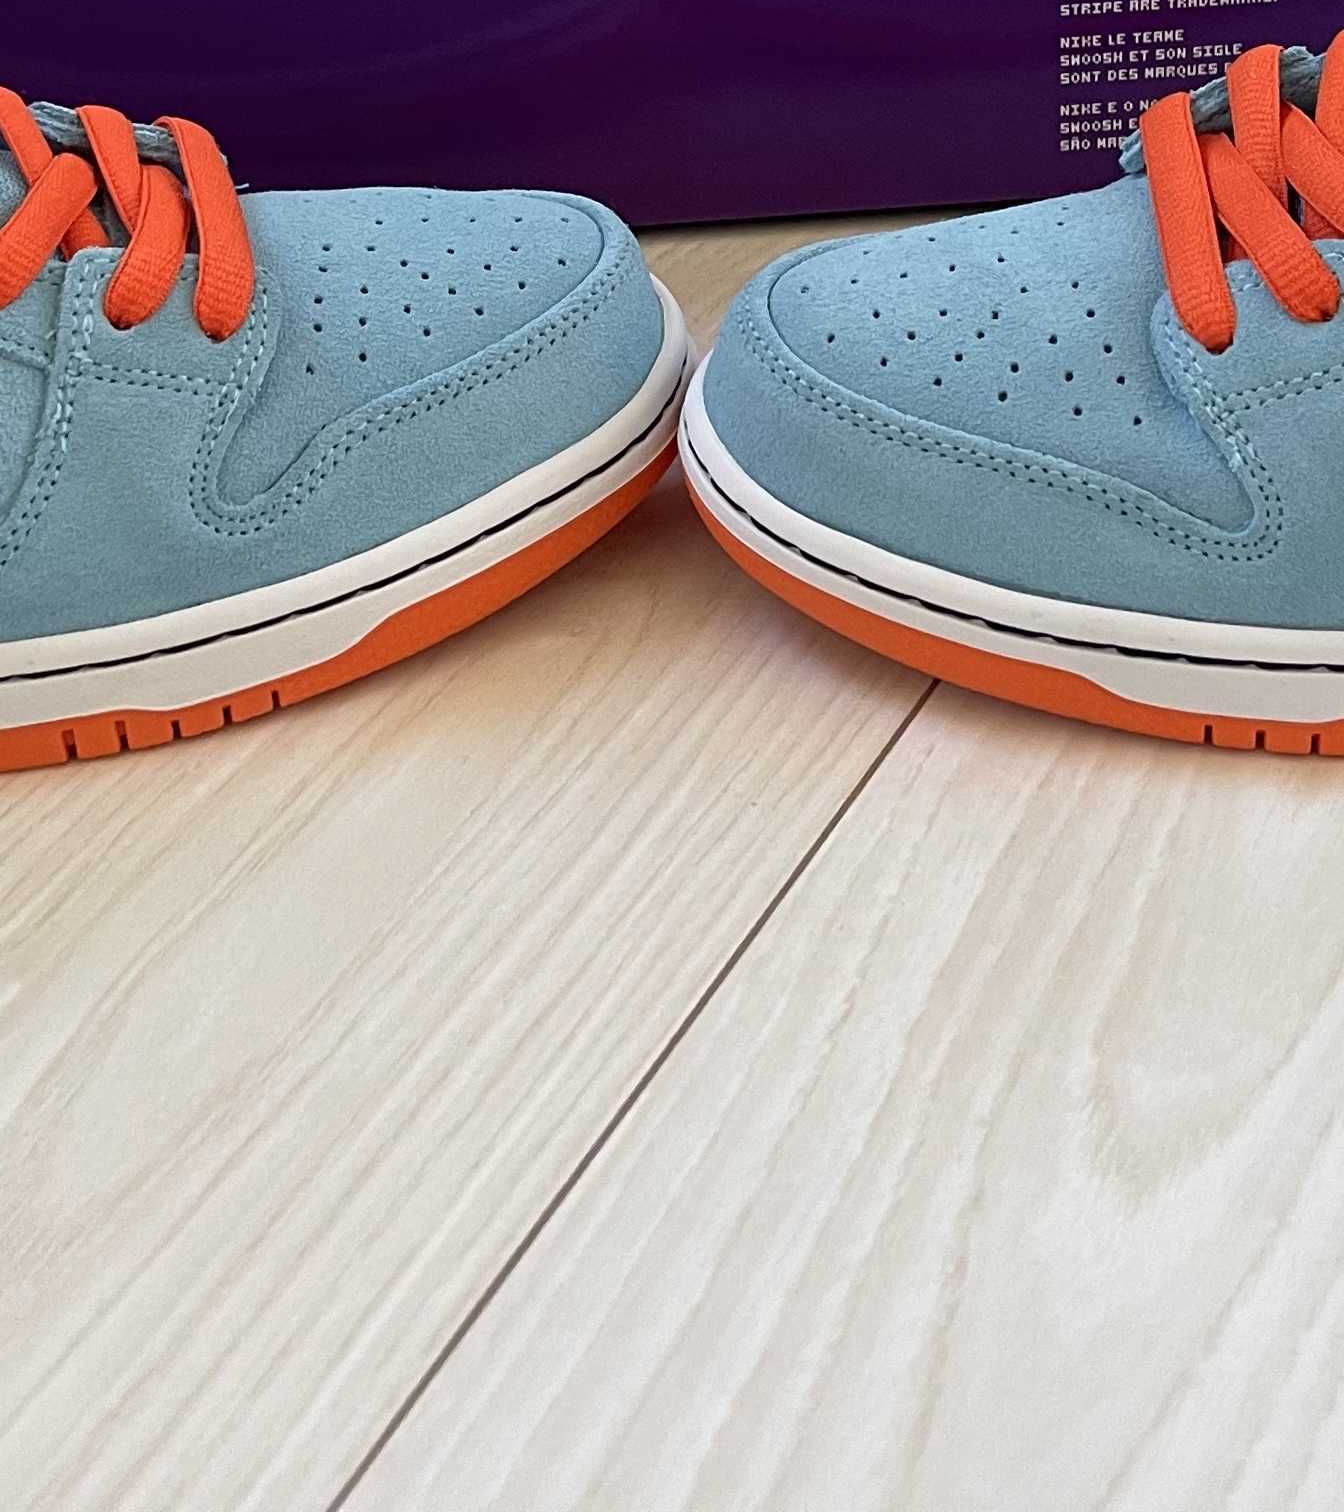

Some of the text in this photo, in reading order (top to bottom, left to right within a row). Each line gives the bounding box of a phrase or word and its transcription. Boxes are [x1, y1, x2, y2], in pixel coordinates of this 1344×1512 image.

[1060, 0, 1123, 16] STRIPE
[1060, 29, 1184, 49] NIKE LE TERME
[1060, 43, 1243, 67] SWOOSH ET SON SIGLE
[1060, 70, 1101, 85] SONT
[1107, 68, 1138, 82] DES
[1144, 62, 1218, 79] MARQUES
[1060, 102, 1101, 117] NIKE
[1107, 101, 1117, 113] E
[1060, 119, 1122, 134] SWOOSH
